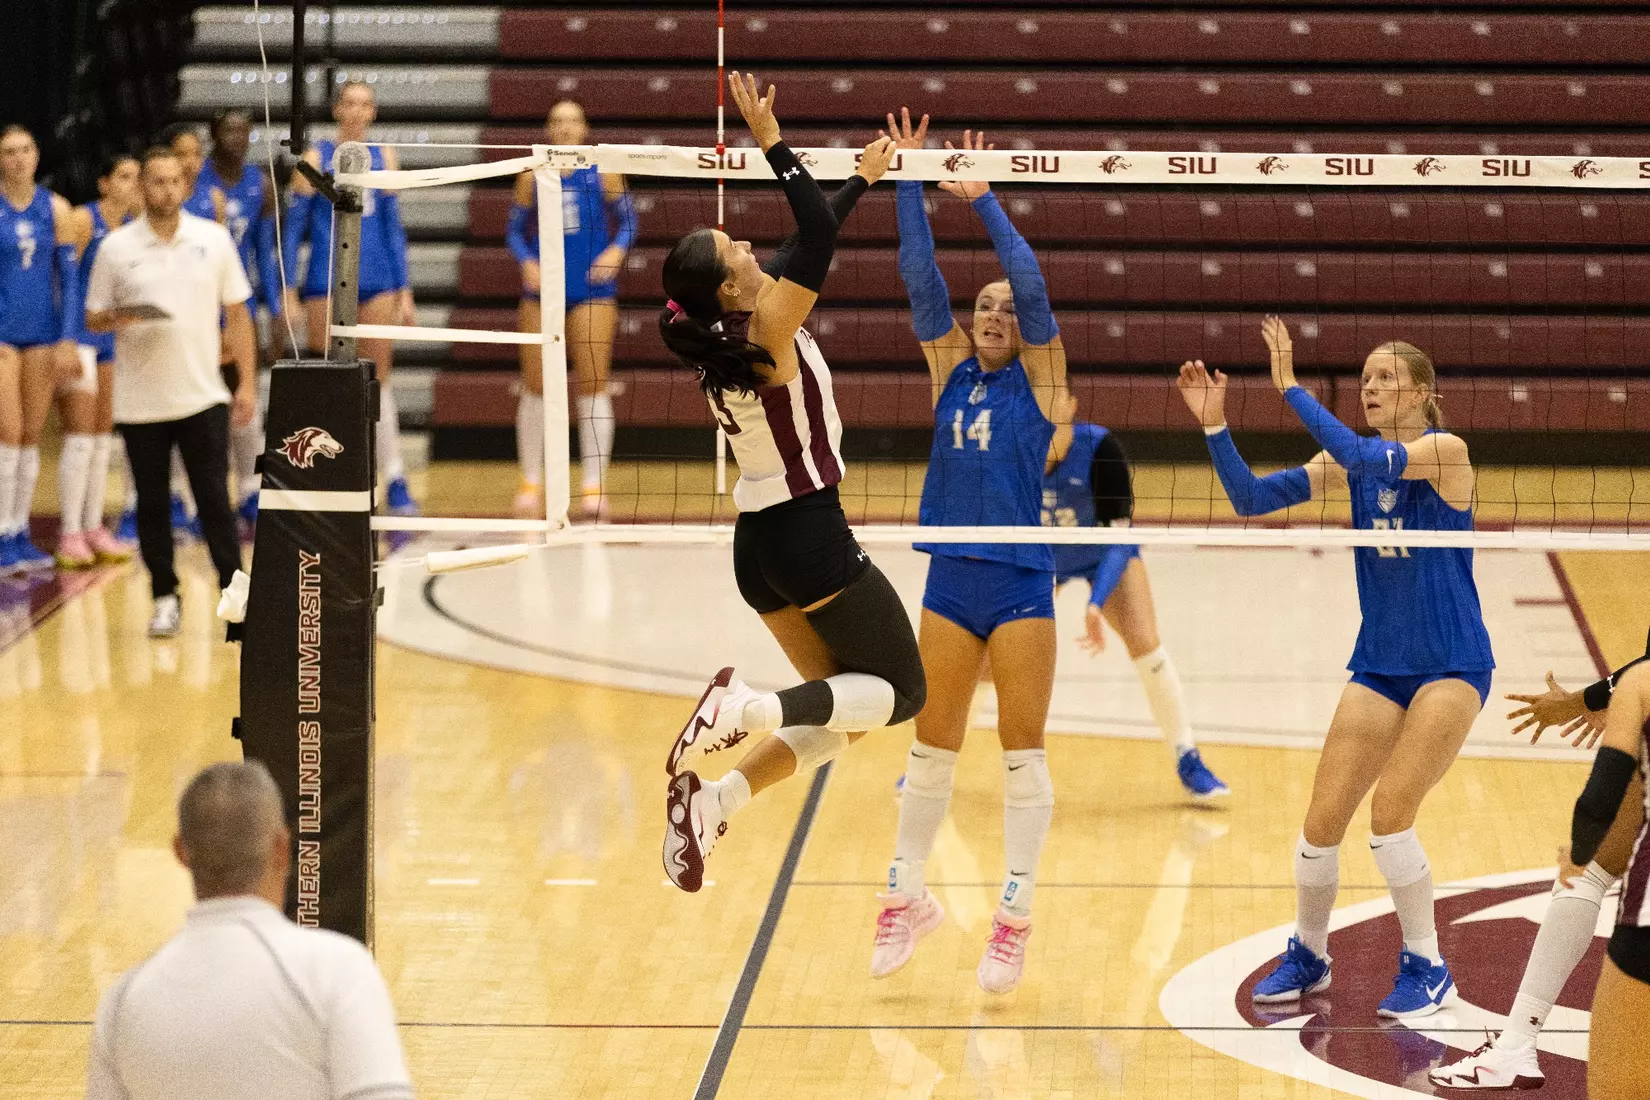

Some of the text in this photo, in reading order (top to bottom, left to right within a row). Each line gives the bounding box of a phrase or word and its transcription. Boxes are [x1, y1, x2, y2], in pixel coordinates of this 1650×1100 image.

[698, 152, 746, 170] SIU
[1011, 155, 1060, 173] SIU
[1168, 156, 1217, 174] SIU
[1325, 157, 1374, 176] SIU
[1482, 159, 1531, 177] SIU
[953, 408, 992, 451] 14
[299, 549, 321, 713] UNIVERSITY
[299, 721, 321, 833] ILLINOIS
